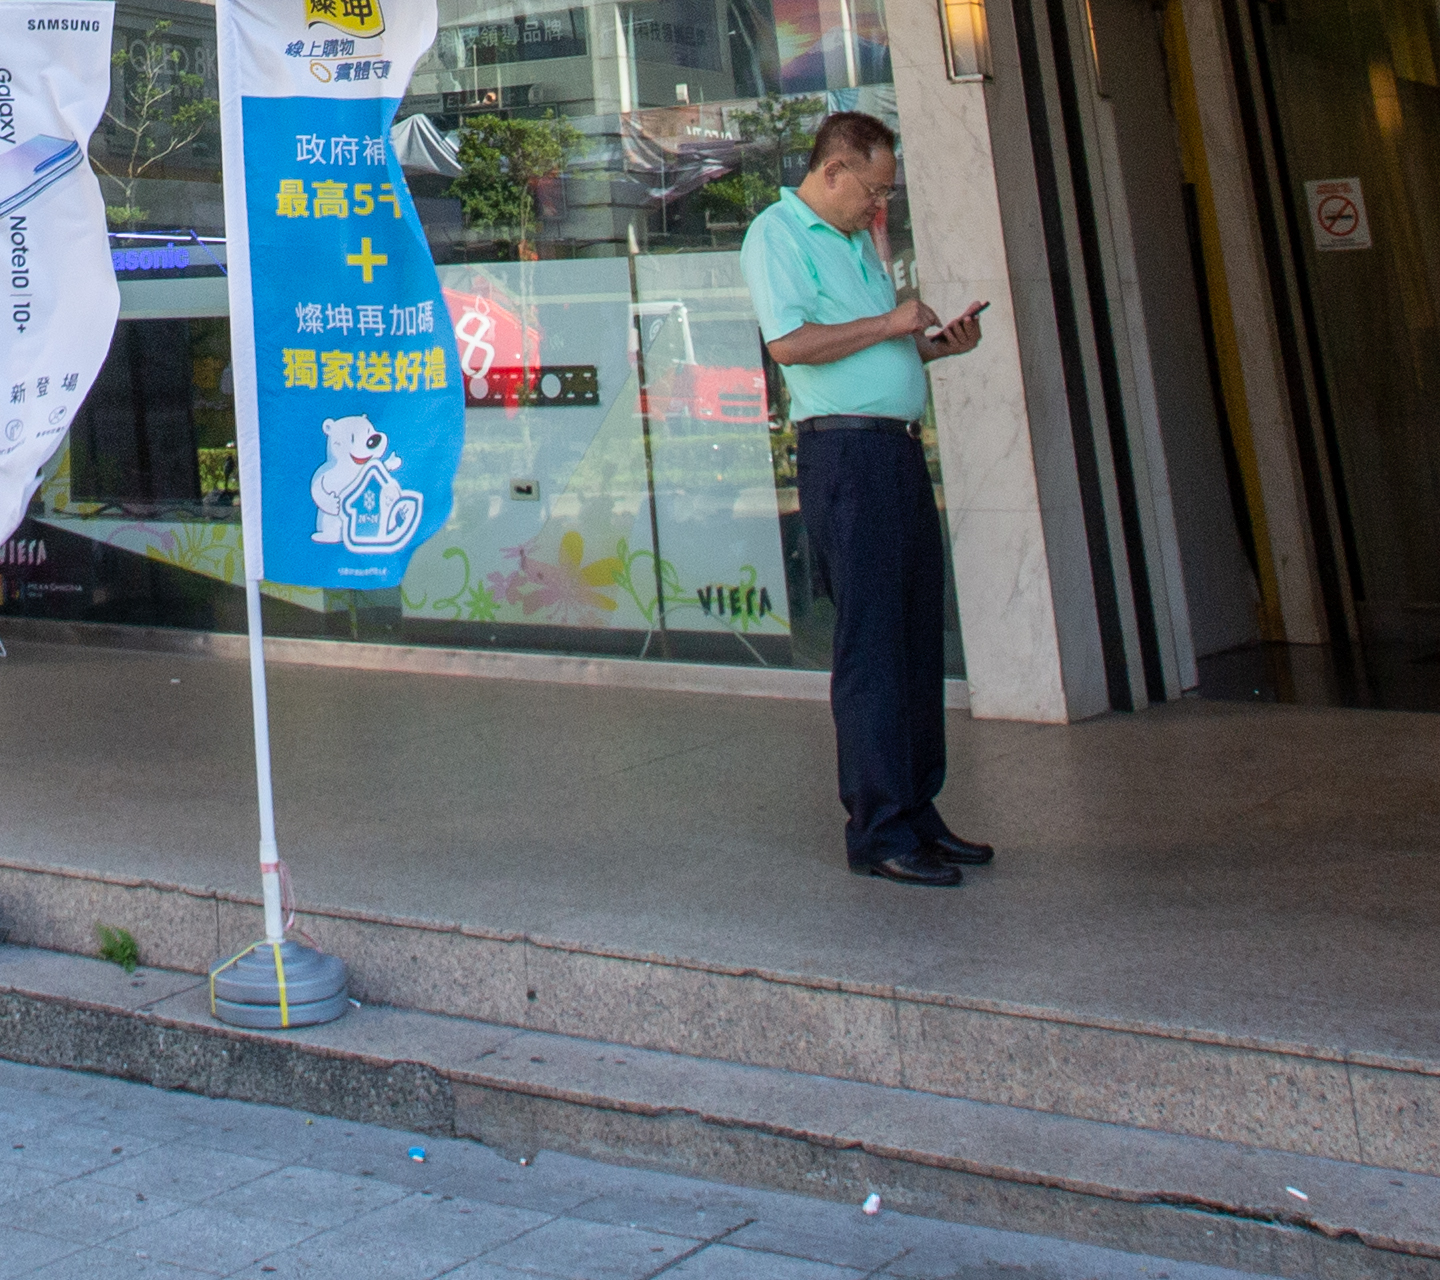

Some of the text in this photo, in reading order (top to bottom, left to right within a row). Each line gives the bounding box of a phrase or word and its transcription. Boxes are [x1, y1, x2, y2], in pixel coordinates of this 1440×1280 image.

[27, 18, 101, 33] SAMSUNG
[285, 38, 355, 58] 線上購物
[9, 215, 31, 334] Note10 10+
[296, 300, 434, 337] 燦坤再加碼
[282, 347, 447, 391] 獨家送好禮
